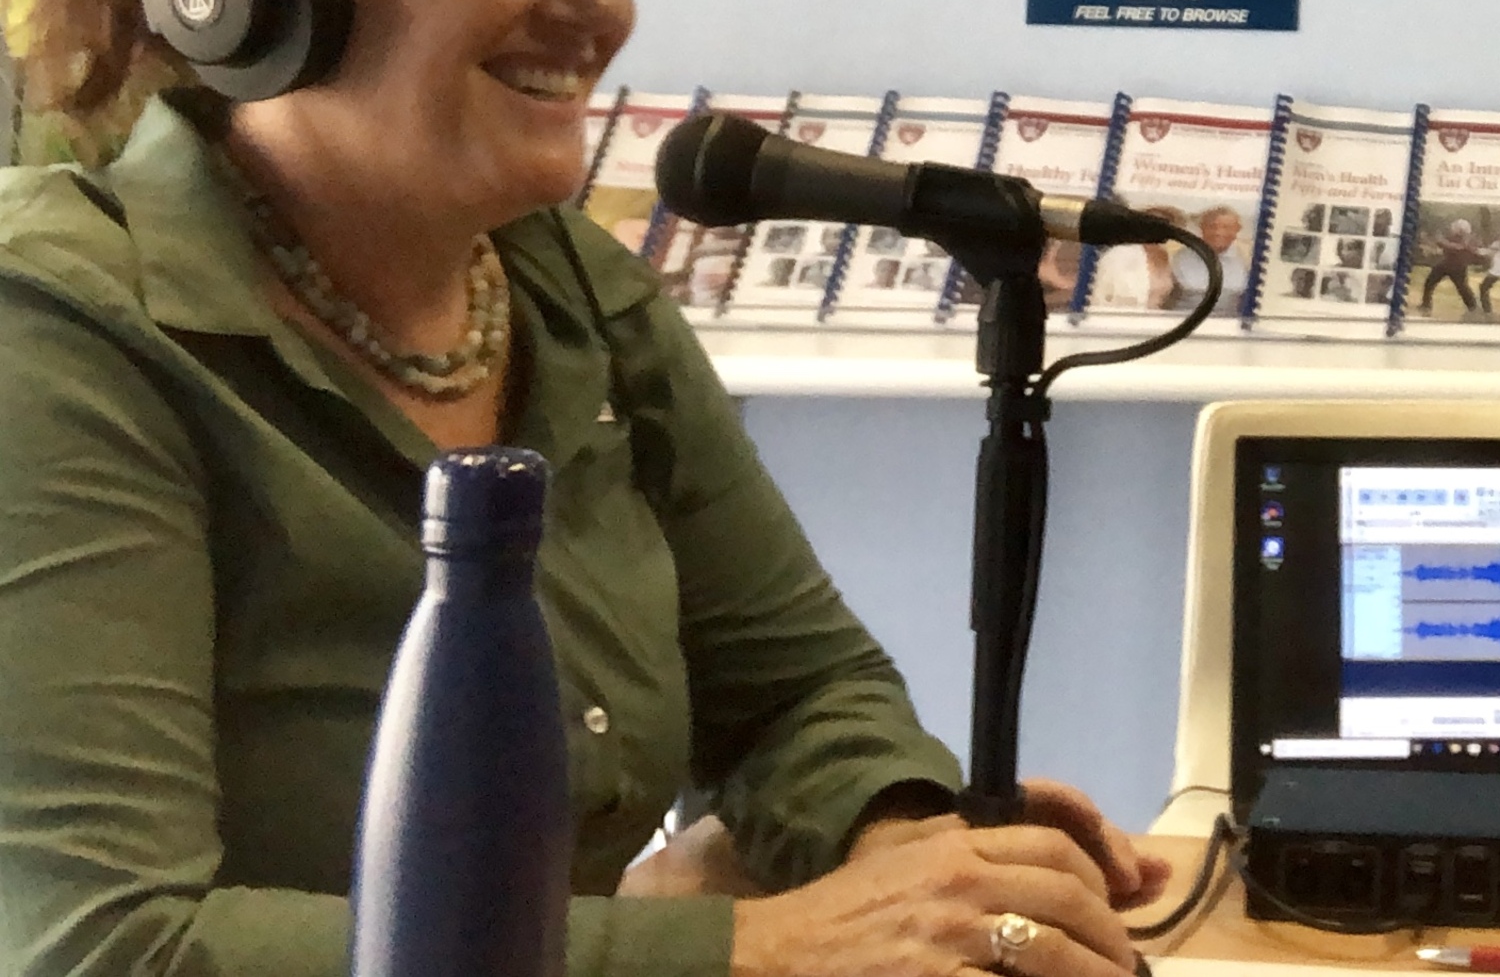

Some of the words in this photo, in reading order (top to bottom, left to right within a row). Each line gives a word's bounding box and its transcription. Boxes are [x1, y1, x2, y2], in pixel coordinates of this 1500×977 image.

[1075, 5, 1111, 20] FEEL
[1116, 6, 1155, 21] FREE
[1160, 7, 1179, 22] TO
[1182, 8, 1250, 24] BROWSE
[1134, 157, 1210, 177] Women's
[1436, 160, 1463, 174] An
[1292, 165, 1336, 182] Men's
[1340, 171, 1388, 186] Health
[1437, 175, 1461, 188] Tai
[1466, 175, 1498, 190] Chi
[1167, 178, 1198, 190] and
[1327, 185, 1358, 198] and
